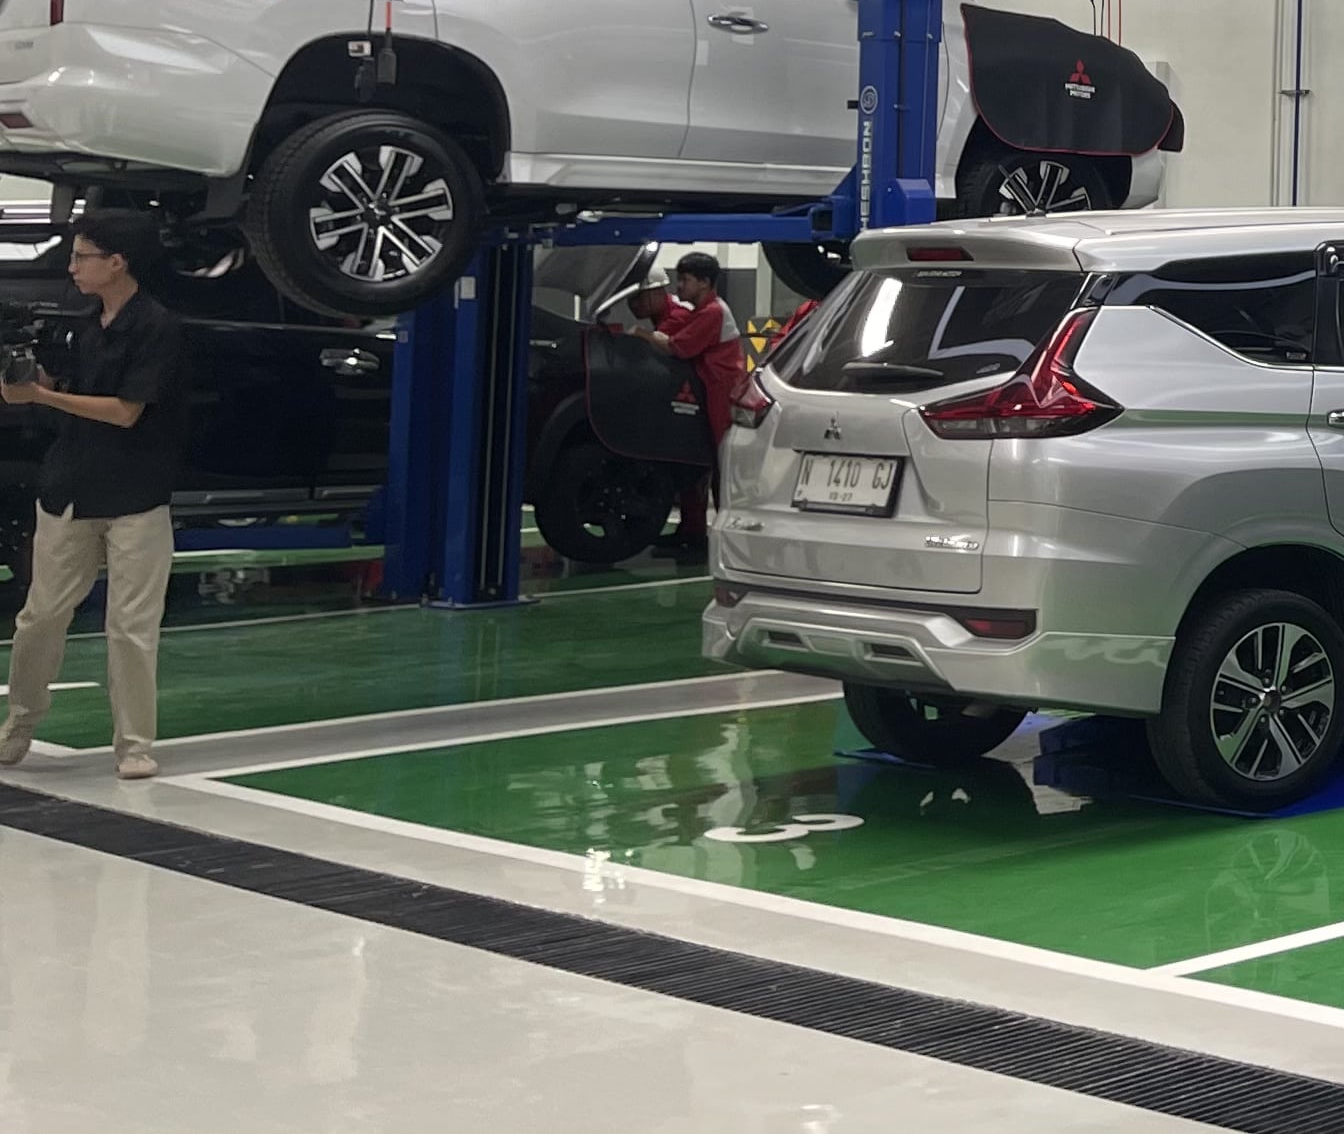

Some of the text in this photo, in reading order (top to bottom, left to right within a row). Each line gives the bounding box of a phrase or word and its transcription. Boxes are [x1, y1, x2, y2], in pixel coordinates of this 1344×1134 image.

[801, 458, 894, 490] N 1410 GJ
[703, 813, 865, 843] 3
